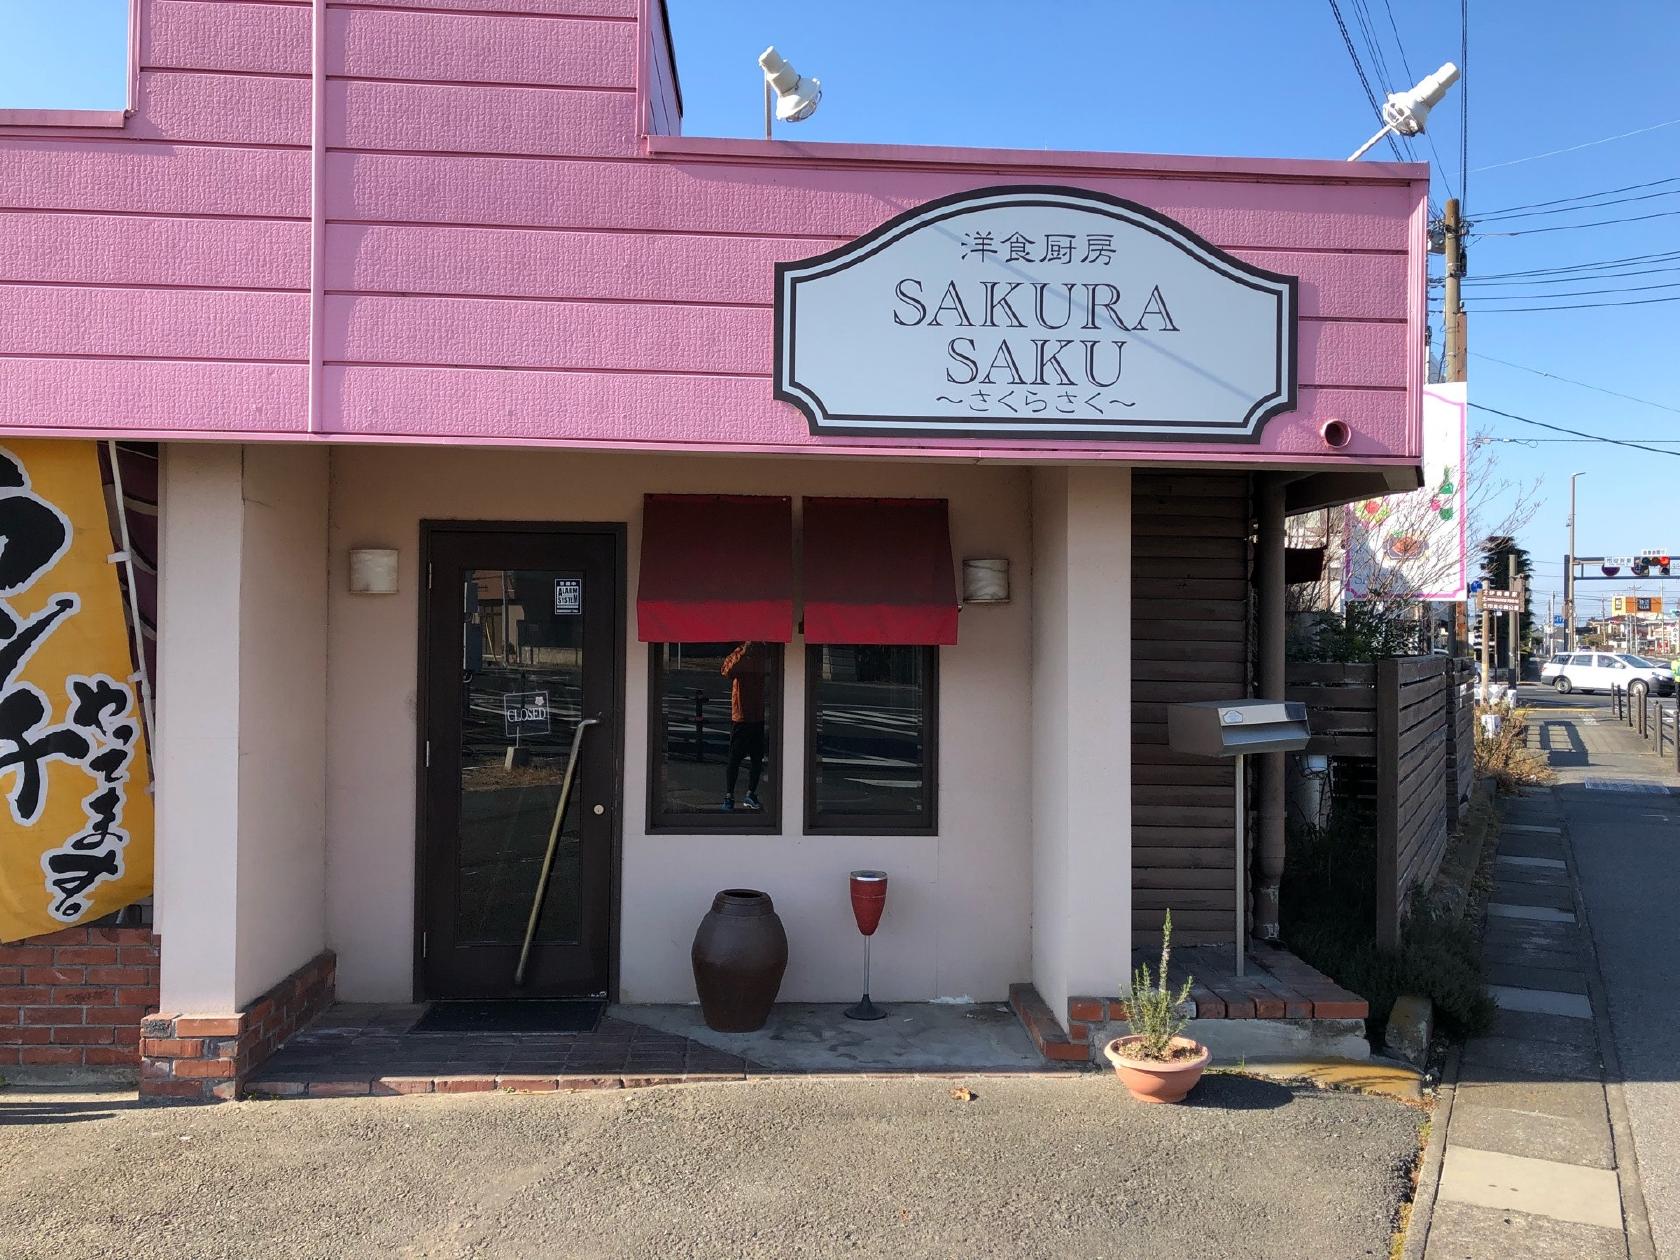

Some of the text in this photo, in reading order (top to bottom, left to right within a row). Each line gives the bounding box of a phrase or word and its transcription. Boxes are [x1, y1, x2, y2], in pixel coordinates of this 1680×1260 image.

[961, 231, 1117, 266] 洋食厨房
[892, 278, 1180, 332] SAKURA
[946, 337, 1127, 388] SAKU
[507, 707, 546, 722] CLOSED
